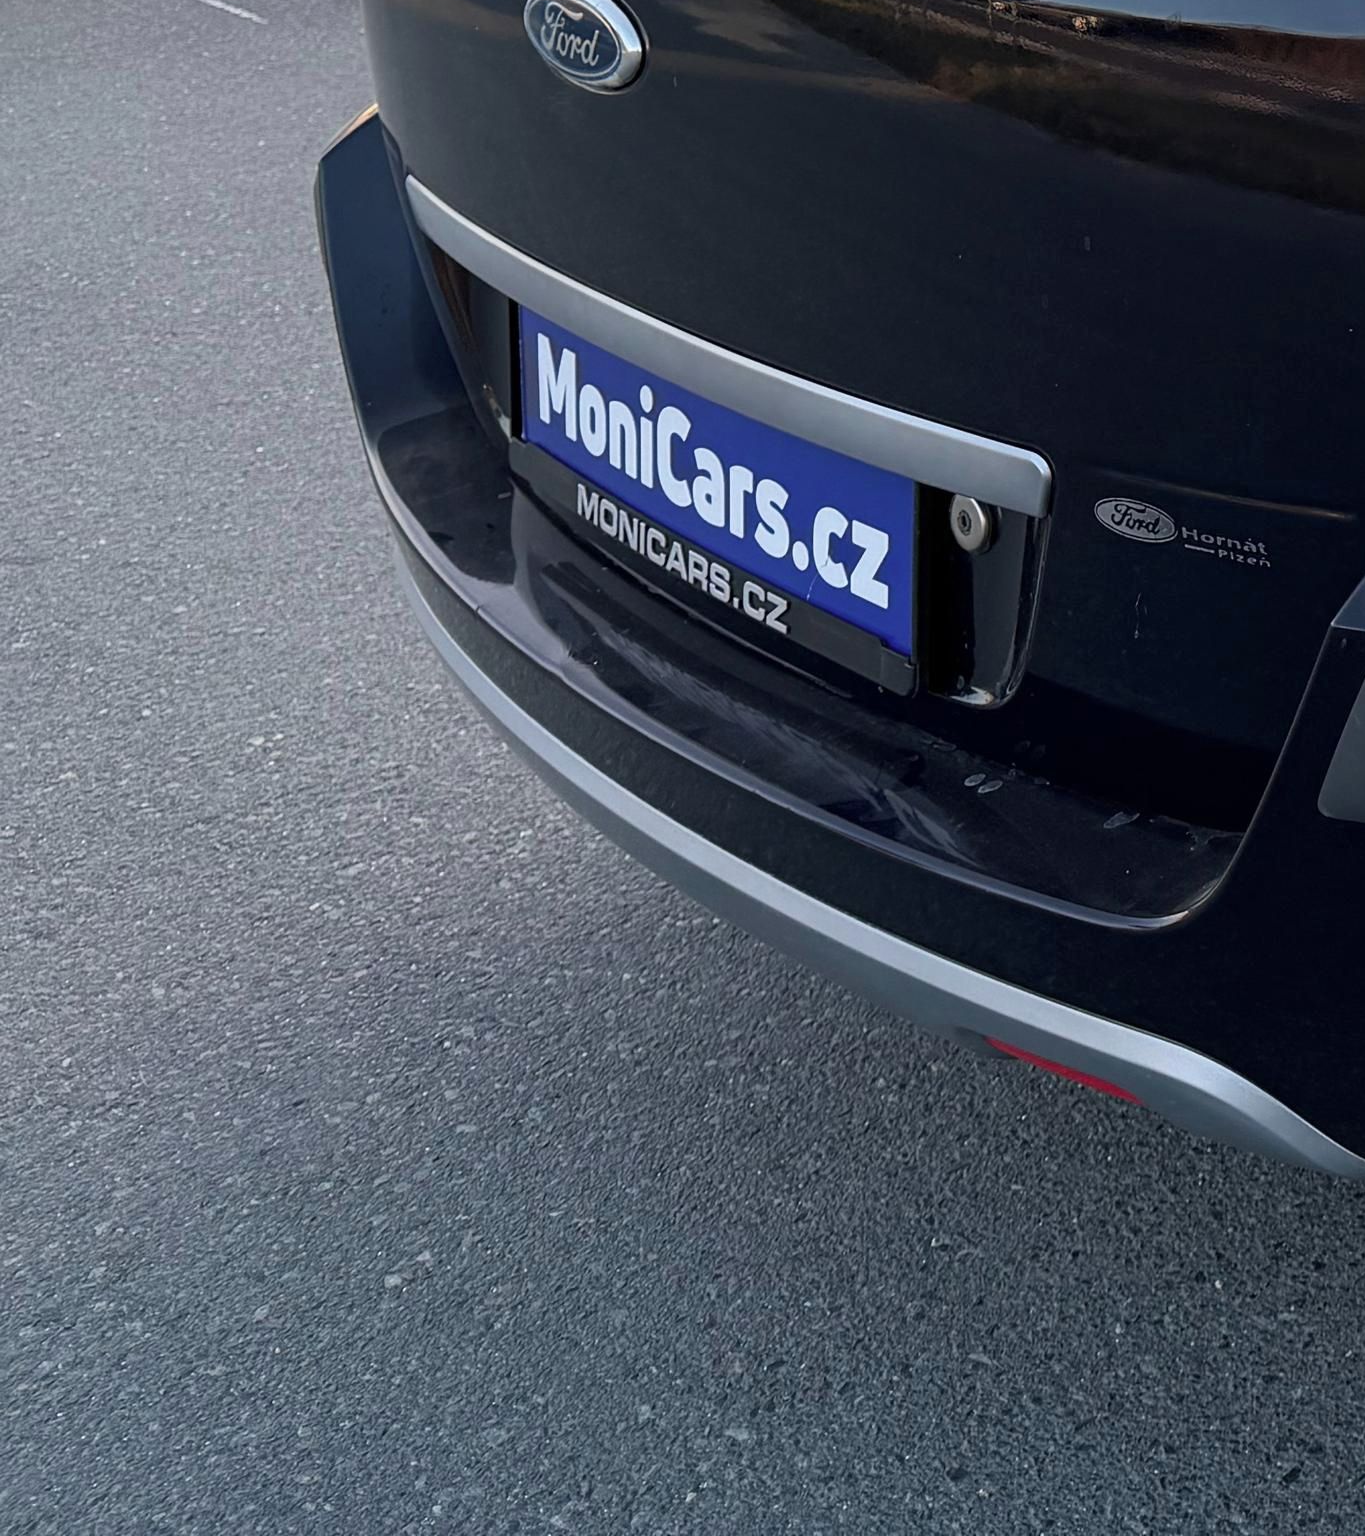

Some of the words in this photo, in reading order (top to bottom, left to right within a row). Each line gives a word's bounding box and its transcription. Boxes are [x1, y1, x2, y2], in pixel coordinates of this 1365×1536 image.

[540, 0, 601, 67] Ford
[536, 331, 890, 610] MoniCars.cz
[1110, 502, 1162, 536] Ford
[576, 482, 793, 635] MONICARS.CZ
